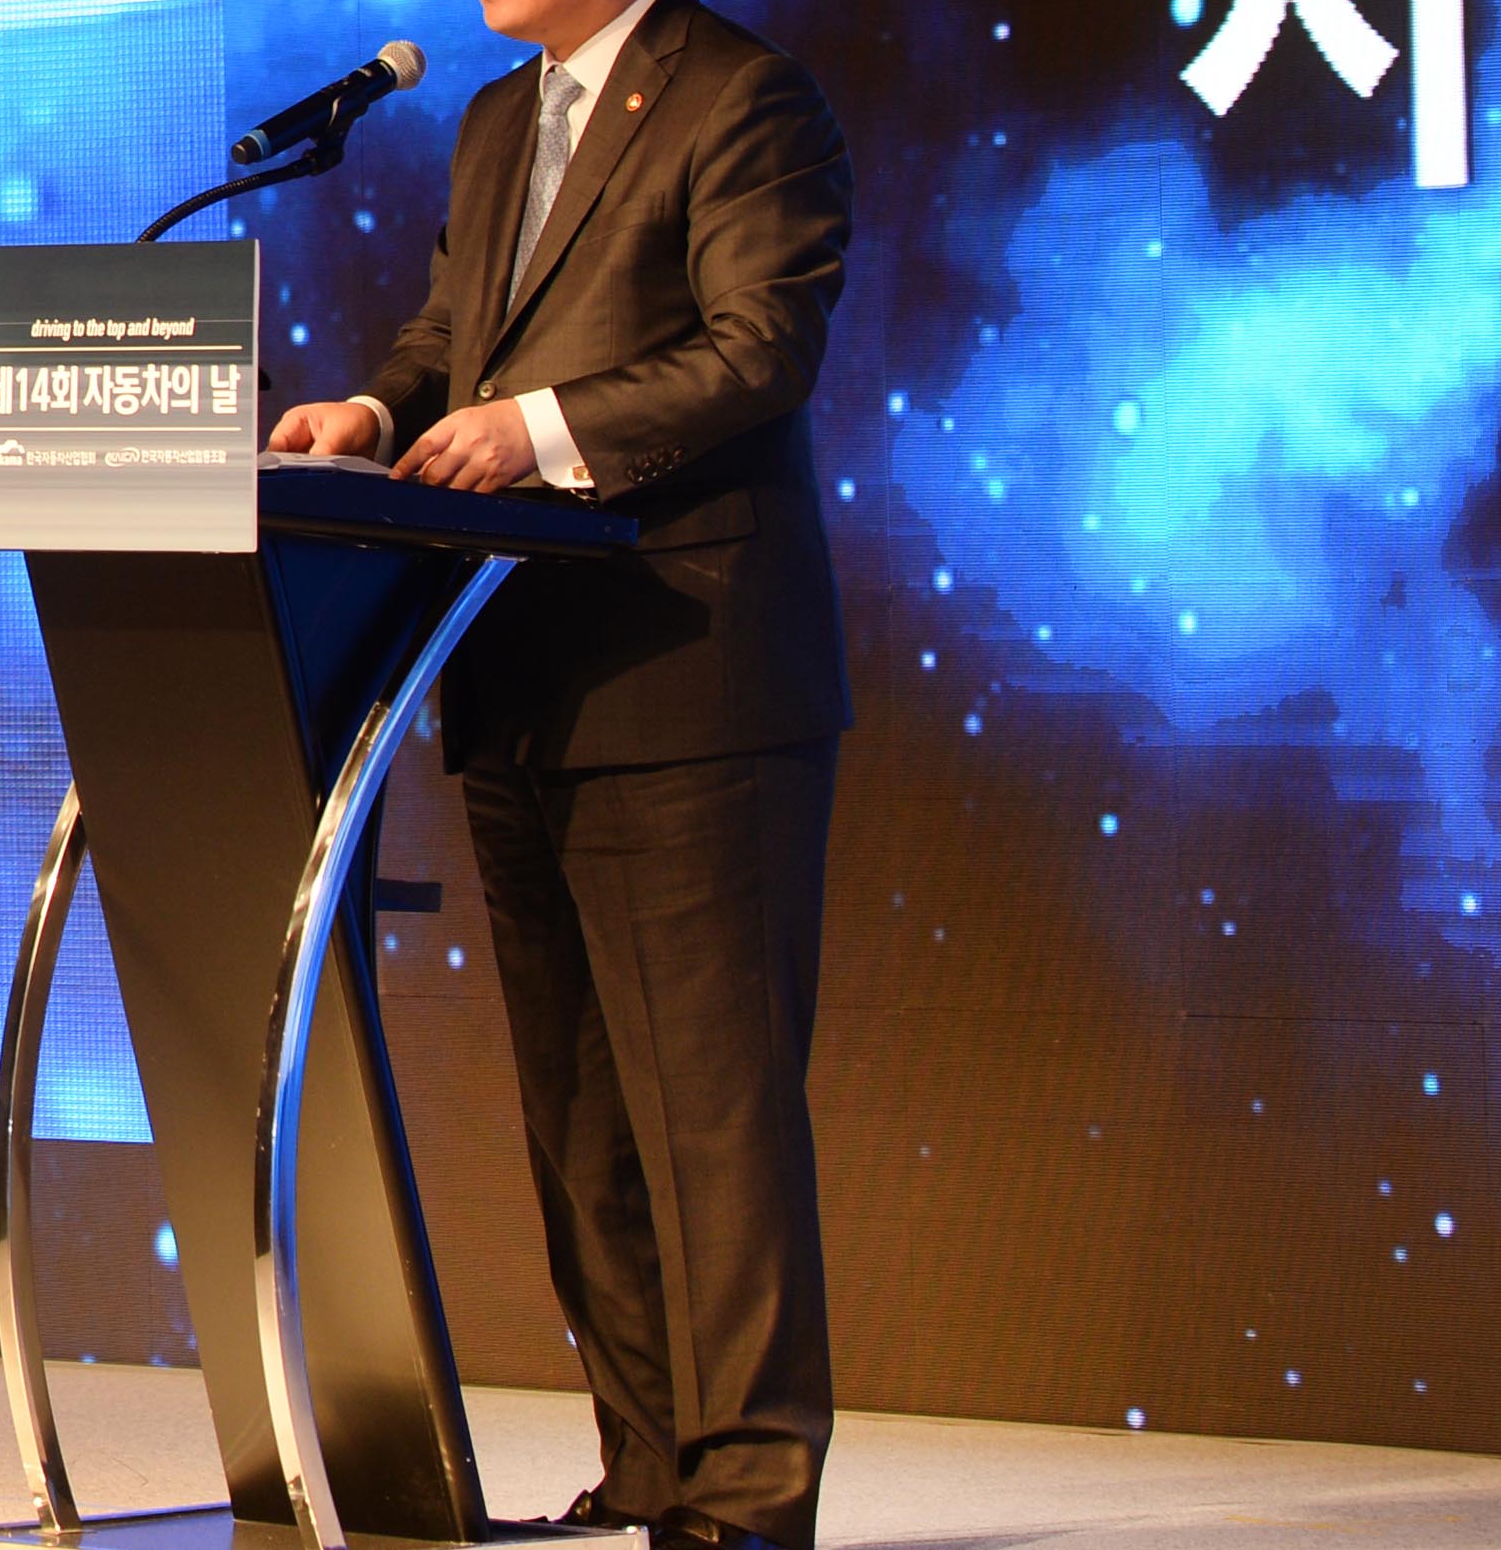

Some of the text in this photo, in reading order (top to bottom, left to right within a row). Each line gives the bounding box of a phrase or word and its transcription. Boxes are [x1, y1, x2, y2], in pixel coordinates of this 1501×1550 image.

[31, 316, 195, 342] driving to the top and beyond
[83, 363, 199, 416] 자동차의
[210, 363, 241, 415] 날
